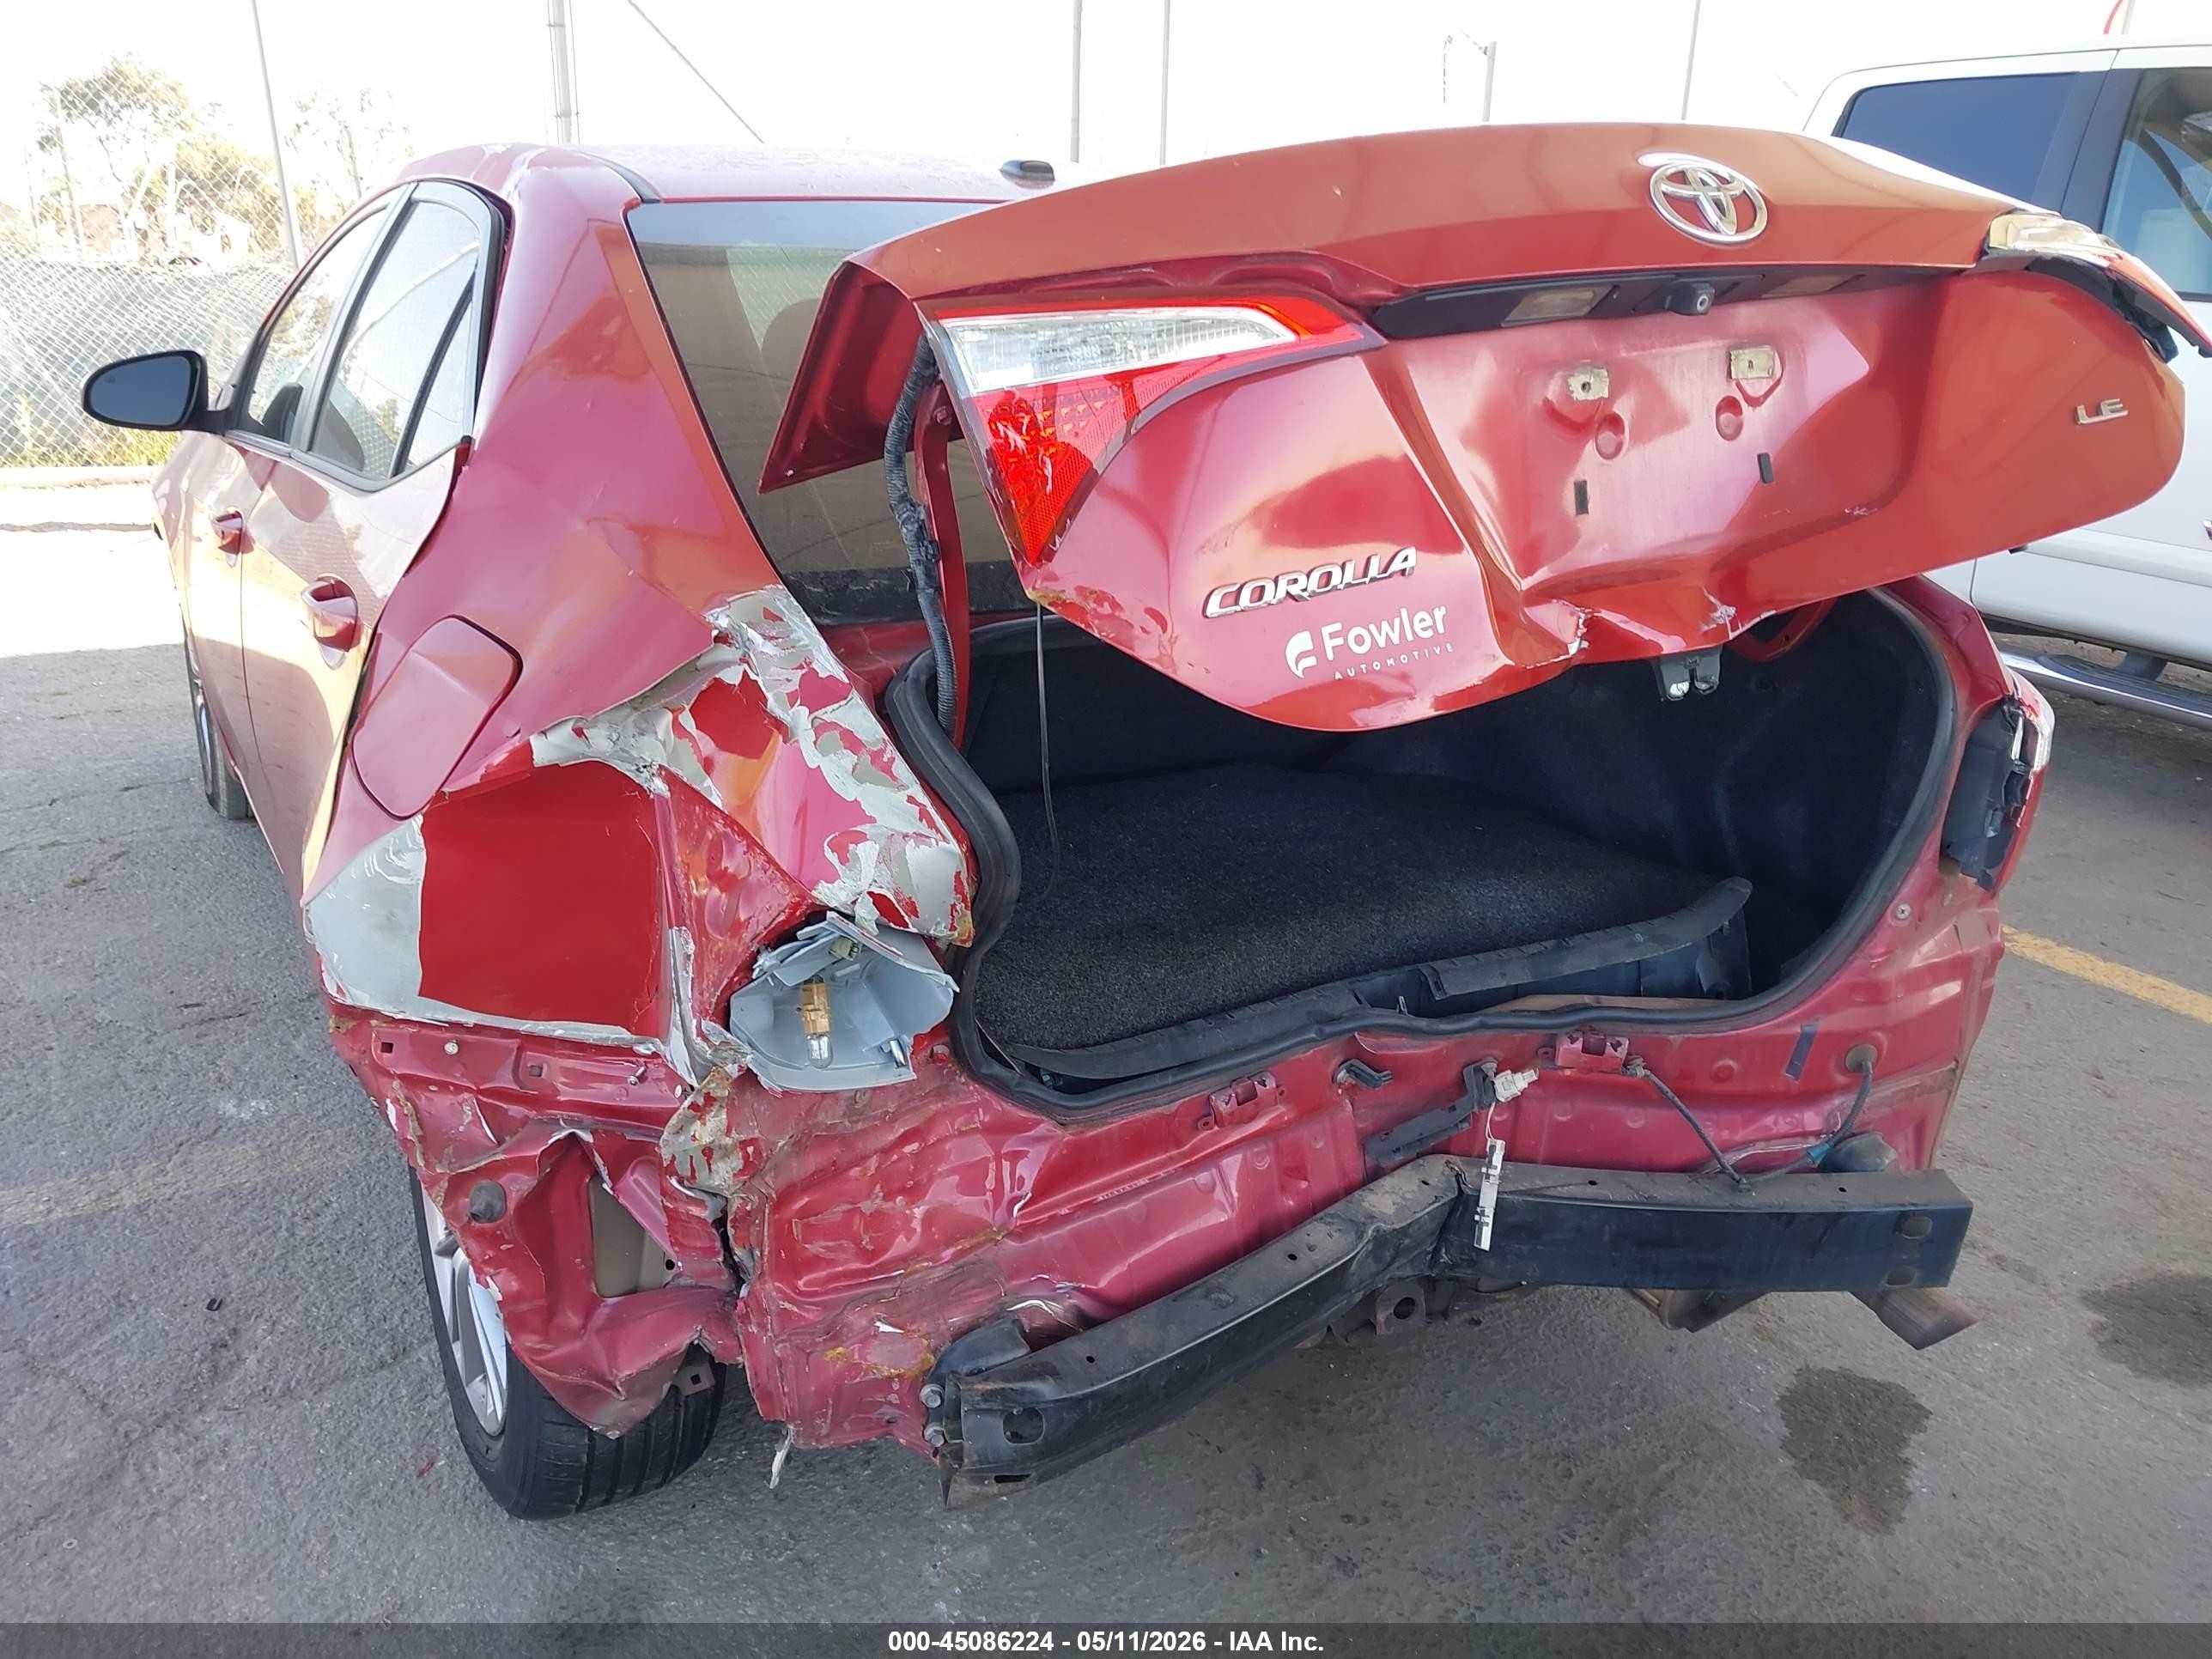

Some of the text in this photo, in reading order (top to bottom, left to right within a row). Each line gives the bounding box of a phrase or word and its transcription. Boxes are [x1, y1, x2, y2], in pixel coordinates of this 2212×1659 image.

[2075, 398, 2129, 425] LE
[1203, 546, 1417, 618] COROLLA
[1321, 605, 1447, 660] Fowler
[1334, 642, 1454, 680] AUTOMOTIVE
